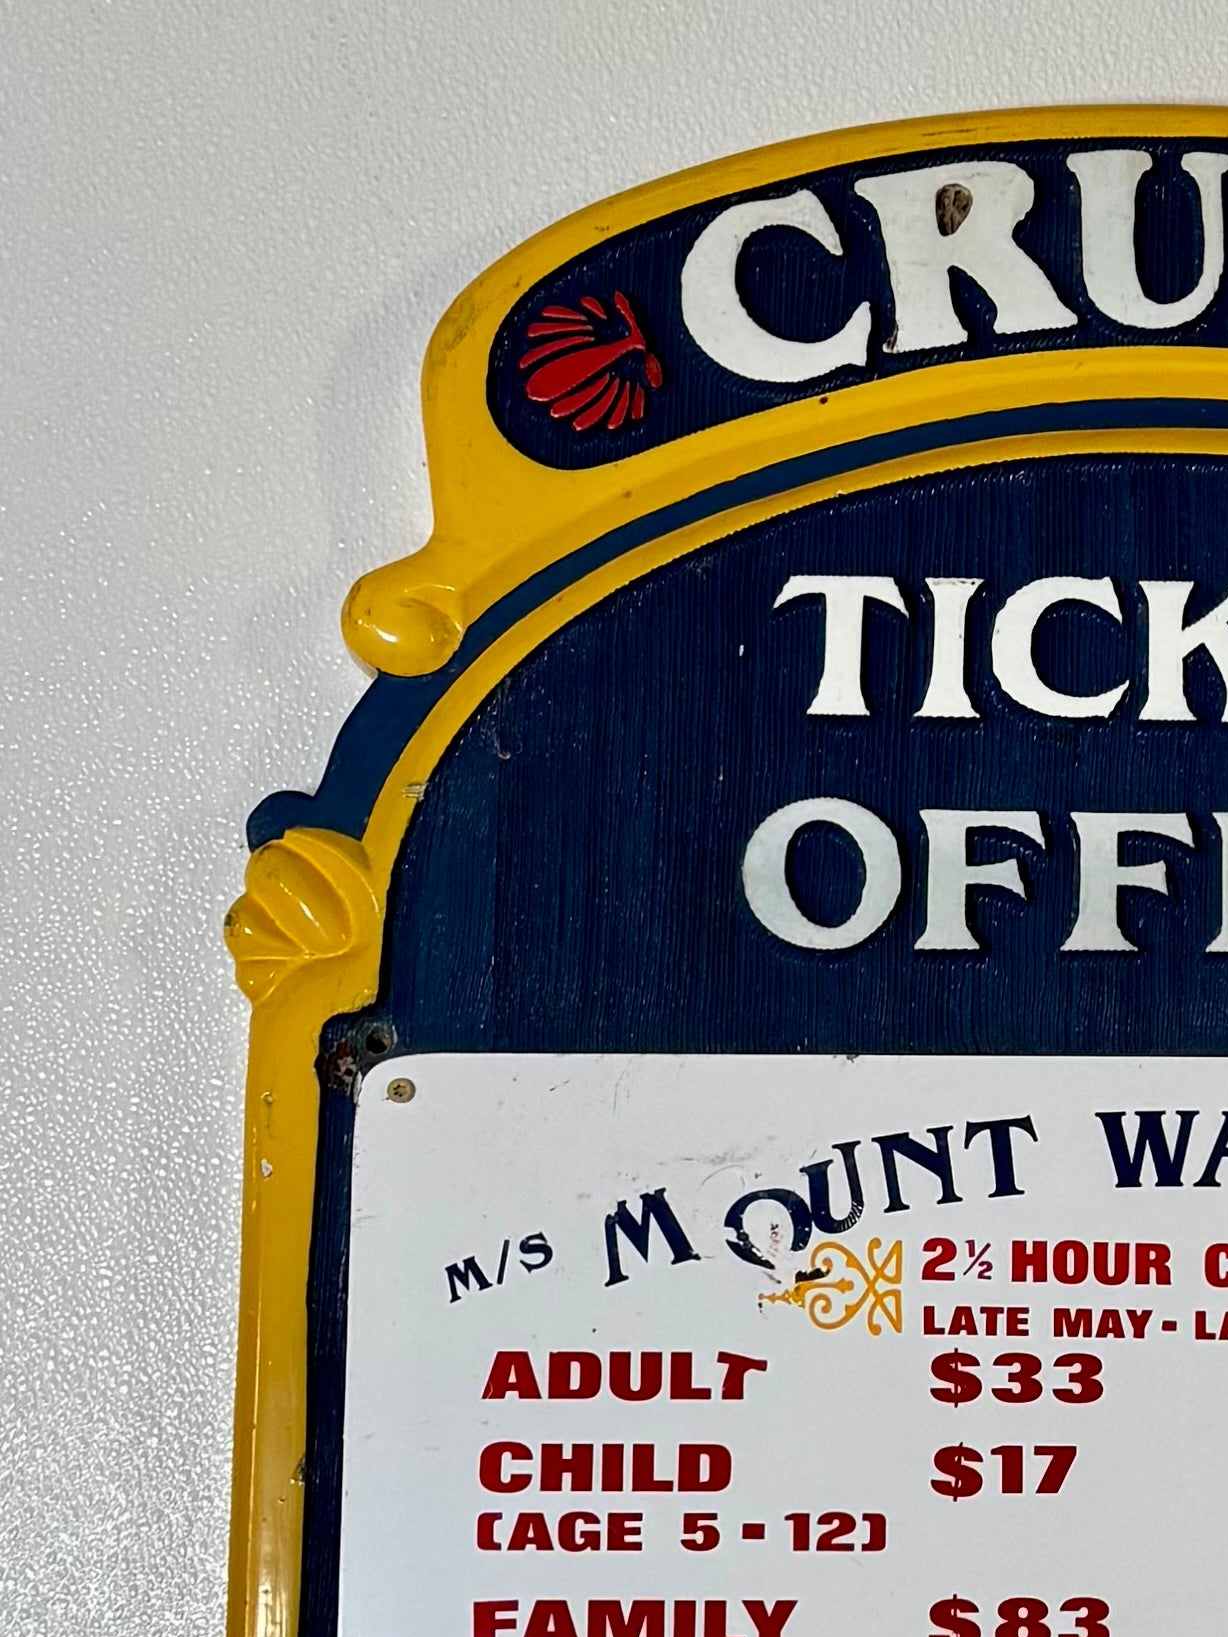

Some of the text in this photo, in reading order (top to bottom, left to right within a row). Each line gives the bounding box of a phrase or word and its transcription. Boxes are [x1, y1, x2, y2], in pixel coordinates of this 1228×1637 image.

[446, 1233, 552, 1303] M/S
[604, 1115, 1038, 1287] MOUNT
[1011, 1239, 1172, 1286] HOUR
[923, 1306, 1029, 1338] LATE
[1053, 1308, 1152, 1340] MAY
[481, 1348, 1105, 1407] ADULT $33
[479, 1442, 1078, 1501] CHILD $17
[681, 1513, 721, 1551] 5
